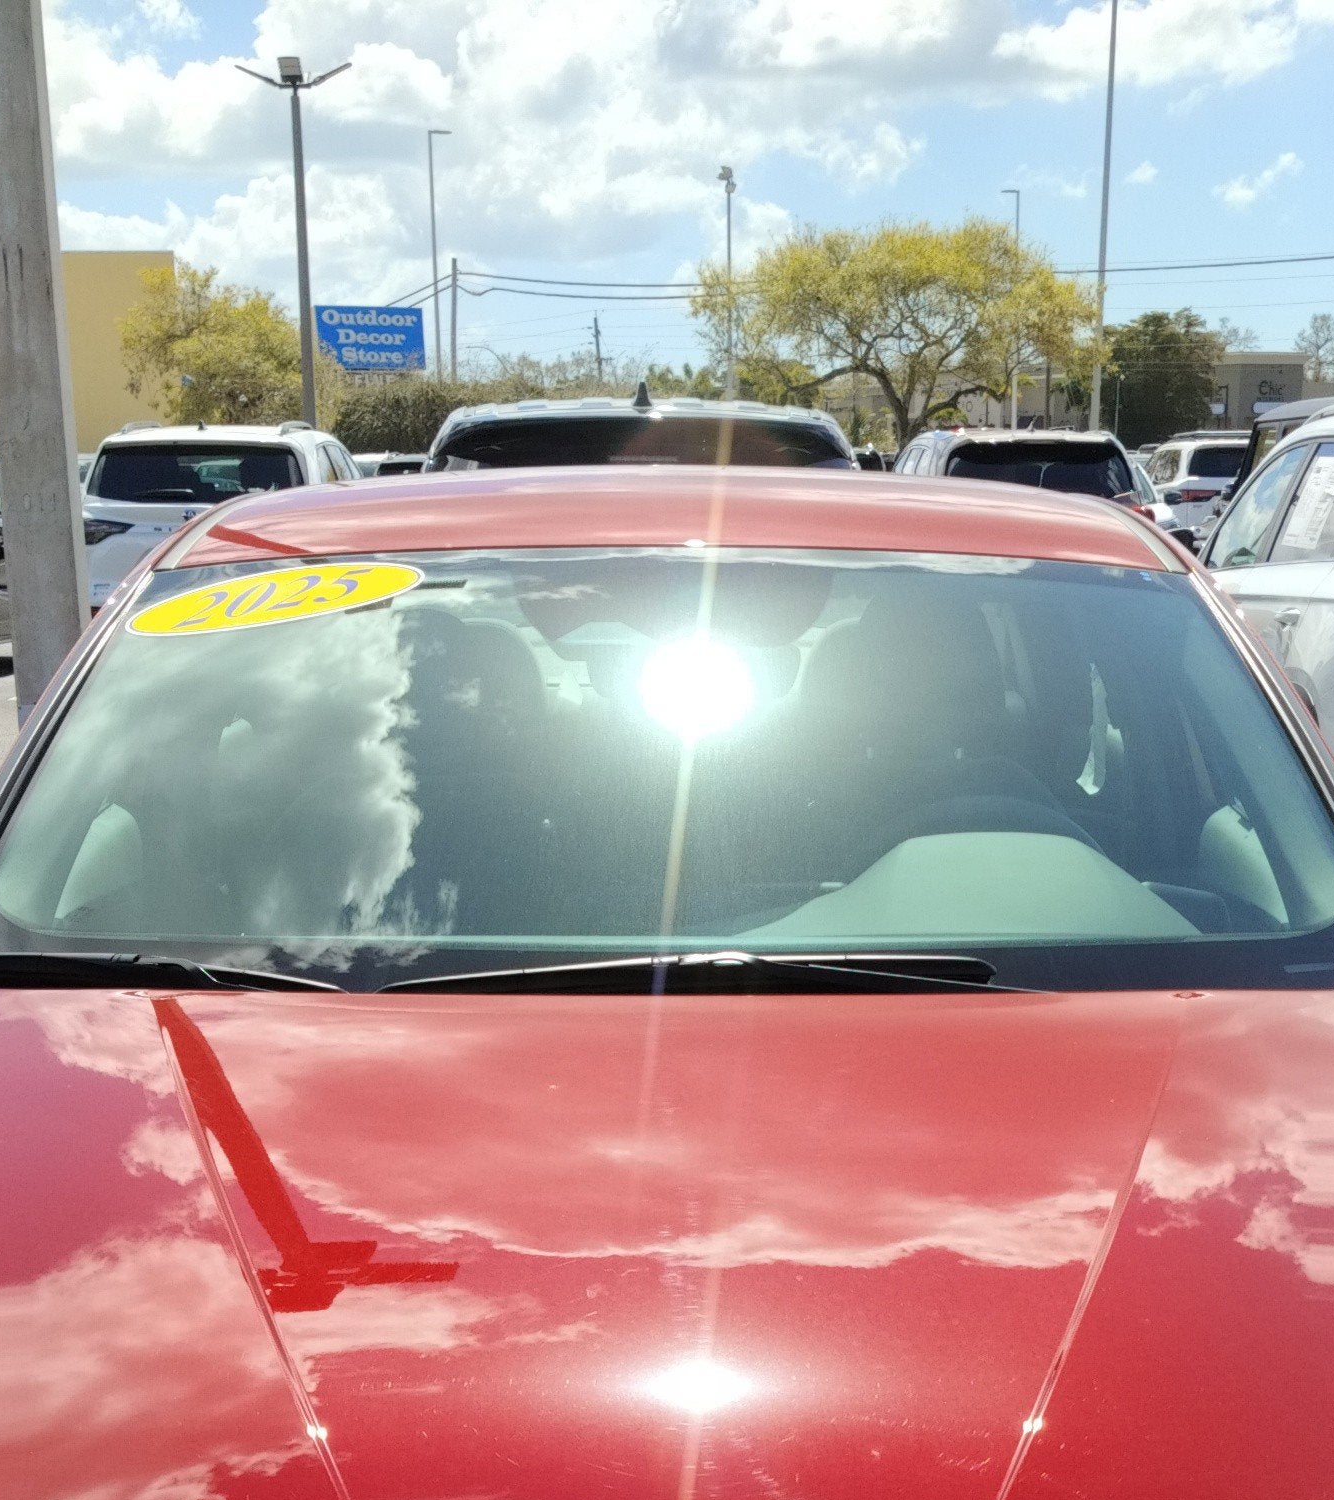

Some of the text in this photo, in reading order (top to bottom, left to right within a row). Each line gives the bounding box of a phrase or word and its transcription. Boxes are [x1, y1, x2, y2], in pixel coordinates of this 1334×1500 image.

[322, 309, 418, 326] Outdoor
[336, 328, 407, 346] Decor
[341, 346, 405, 365] Store
[171, 568, 373, 629] 2025
